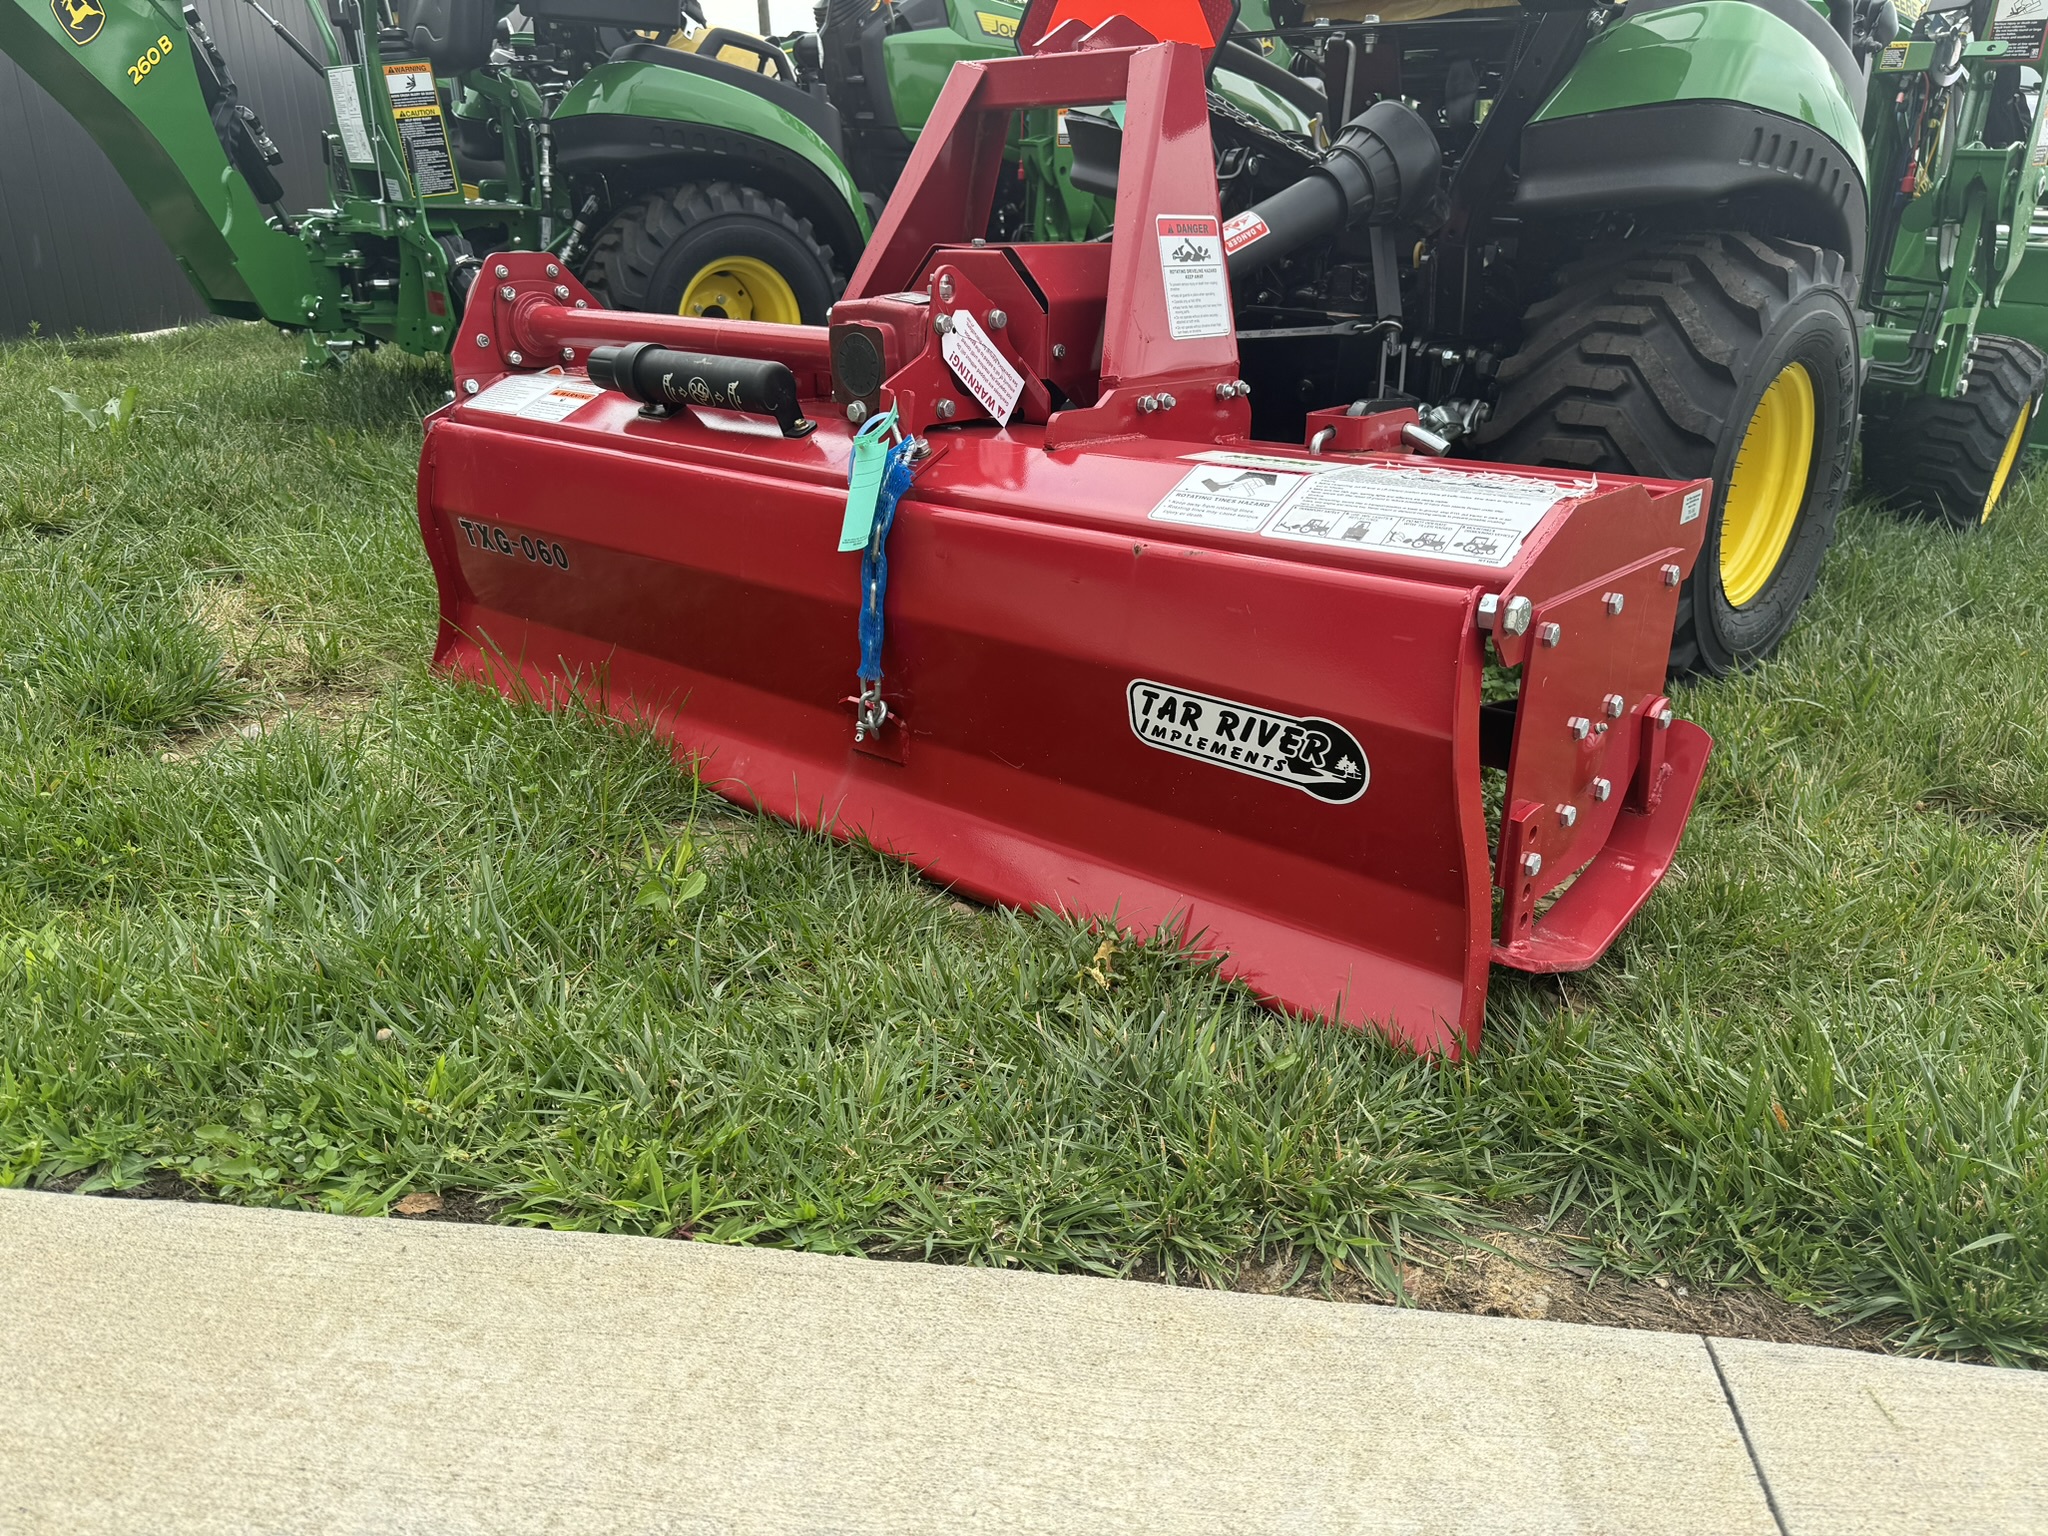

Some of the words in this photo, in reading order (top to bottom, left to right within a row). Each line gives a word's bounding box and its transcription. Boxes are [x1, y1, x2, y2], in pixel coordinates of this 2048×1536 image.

[127, 47, 161, 86] 260
[156, 34, 174, 56] B
[1176, 224, 1209, 234] DANGER
[1226, 228, 1257, 248] DANGER
[948, 350, 996, 412] WARNING!
[458, 516, 570, 570] TXG-060
[1140, 718, 1288, 772] IMPLEMENTS
[1141, 690, 1202, 732] TAR
[1216, 710, 1332, 768] RIVER
